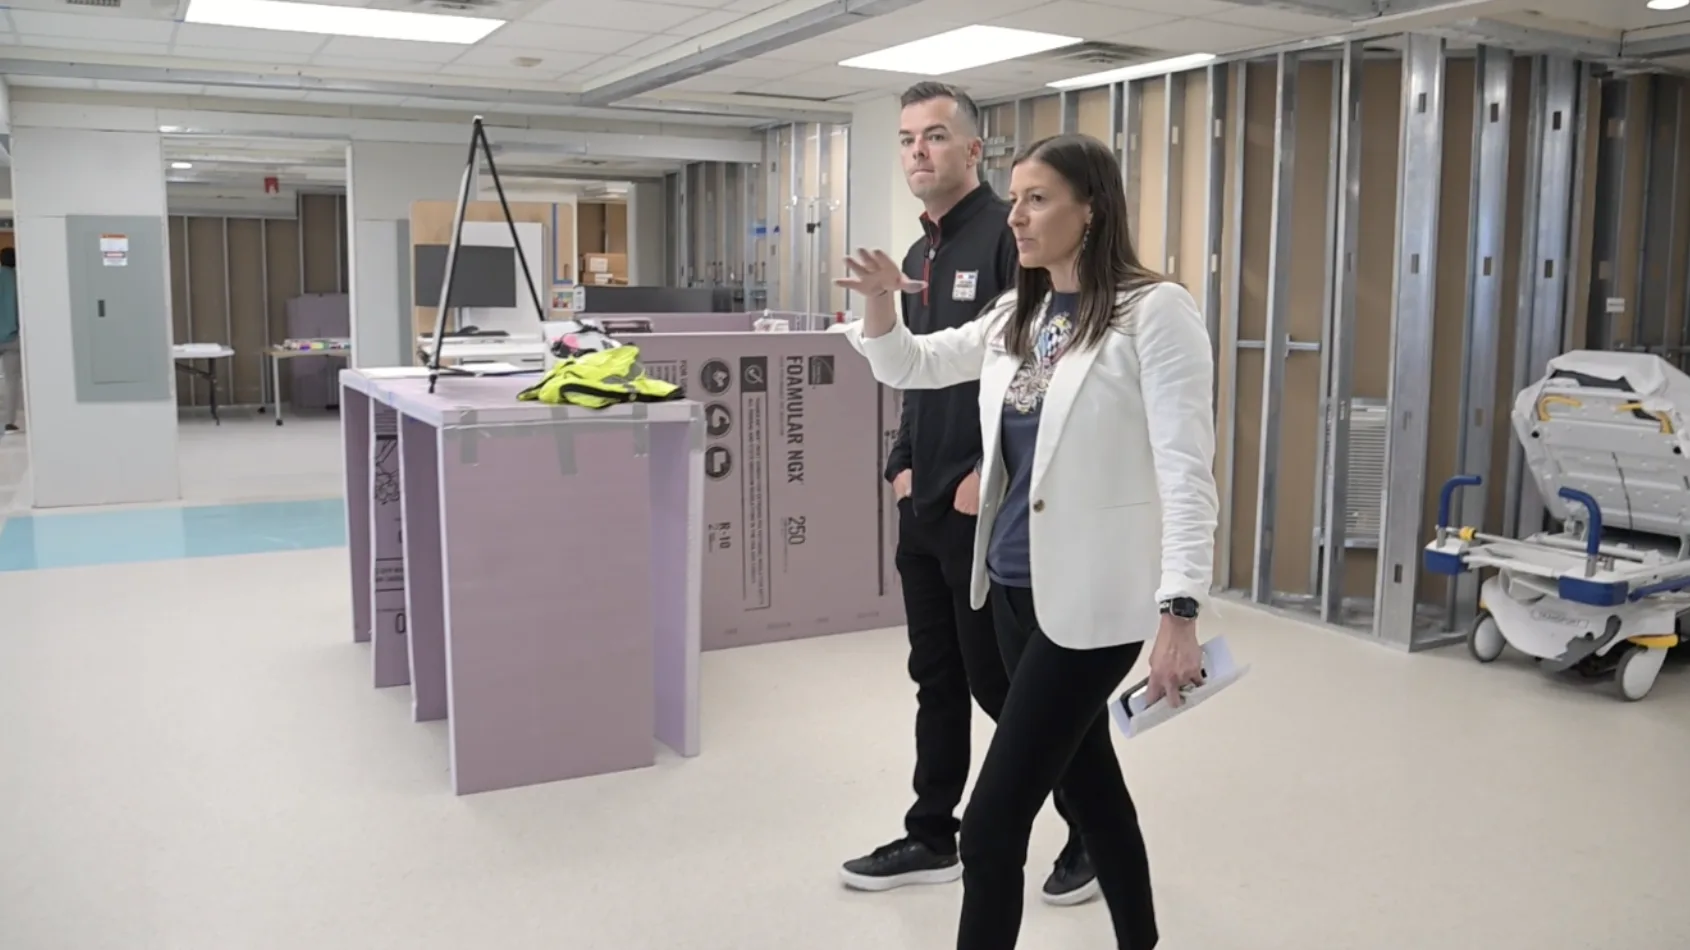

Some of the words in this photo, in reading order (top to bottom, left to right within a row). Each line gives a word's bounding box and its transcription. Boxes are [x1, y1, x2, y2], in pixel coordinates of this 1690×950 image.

[786, 355, 804, 444] FOAMULAR
[787, 450, 804, 484] NGX
[719, 522, 731, 549] R-10
[788, 516, 806, 545] 250
